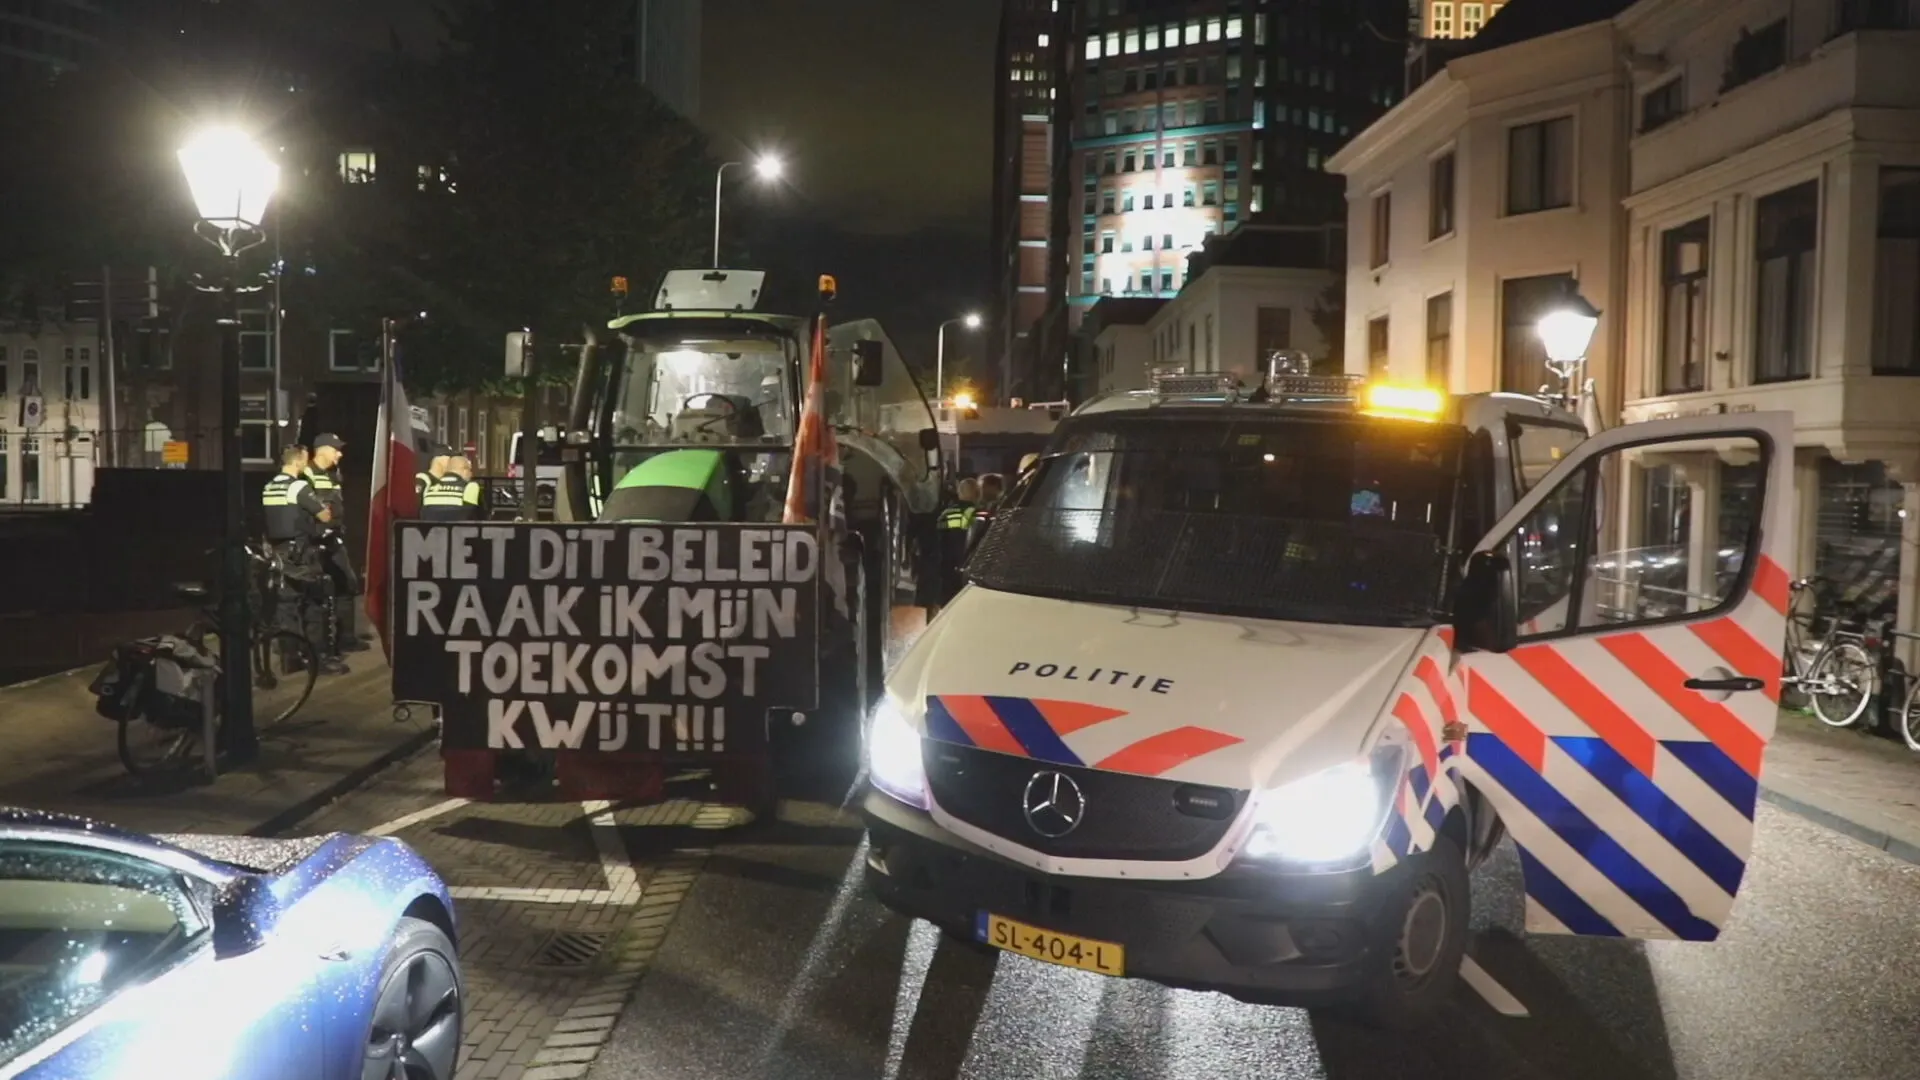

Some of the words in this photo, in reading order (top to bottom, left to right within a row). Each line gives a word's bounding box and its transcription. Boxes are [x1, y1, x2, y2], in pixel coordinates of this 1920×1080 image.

[401, 526, 515, 580] MET
[406, 581, 585, 637] RAAK
[444, 640, 770, 699] TOEKOMST
[1008, 661, 1175, 695] POLITIE
[995, 922, 1110, 970] SL-404-L
